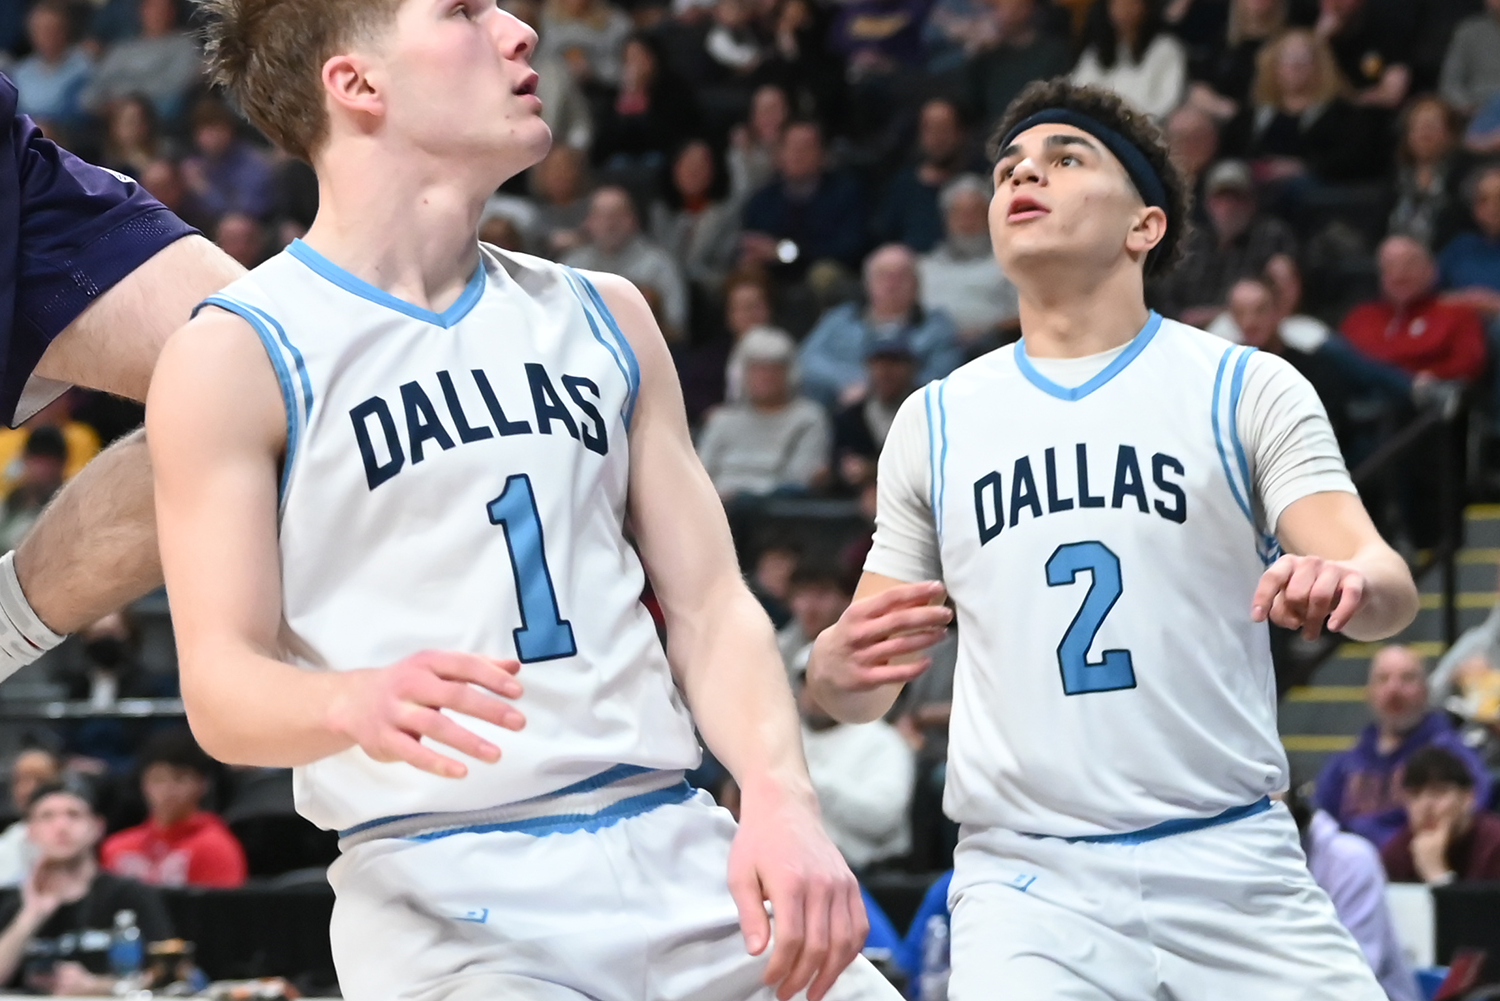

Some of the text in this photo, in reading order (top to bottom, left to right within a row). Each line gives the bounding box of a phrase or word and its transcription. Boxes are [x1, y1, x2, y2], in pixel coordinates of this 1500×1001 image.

[349, 363, 609, 491] DALLAS
[973, 443, 1187, 547] DALLAS
[486, 473, 578, 664] 1
[1044, 540, 1137, 696] 2
